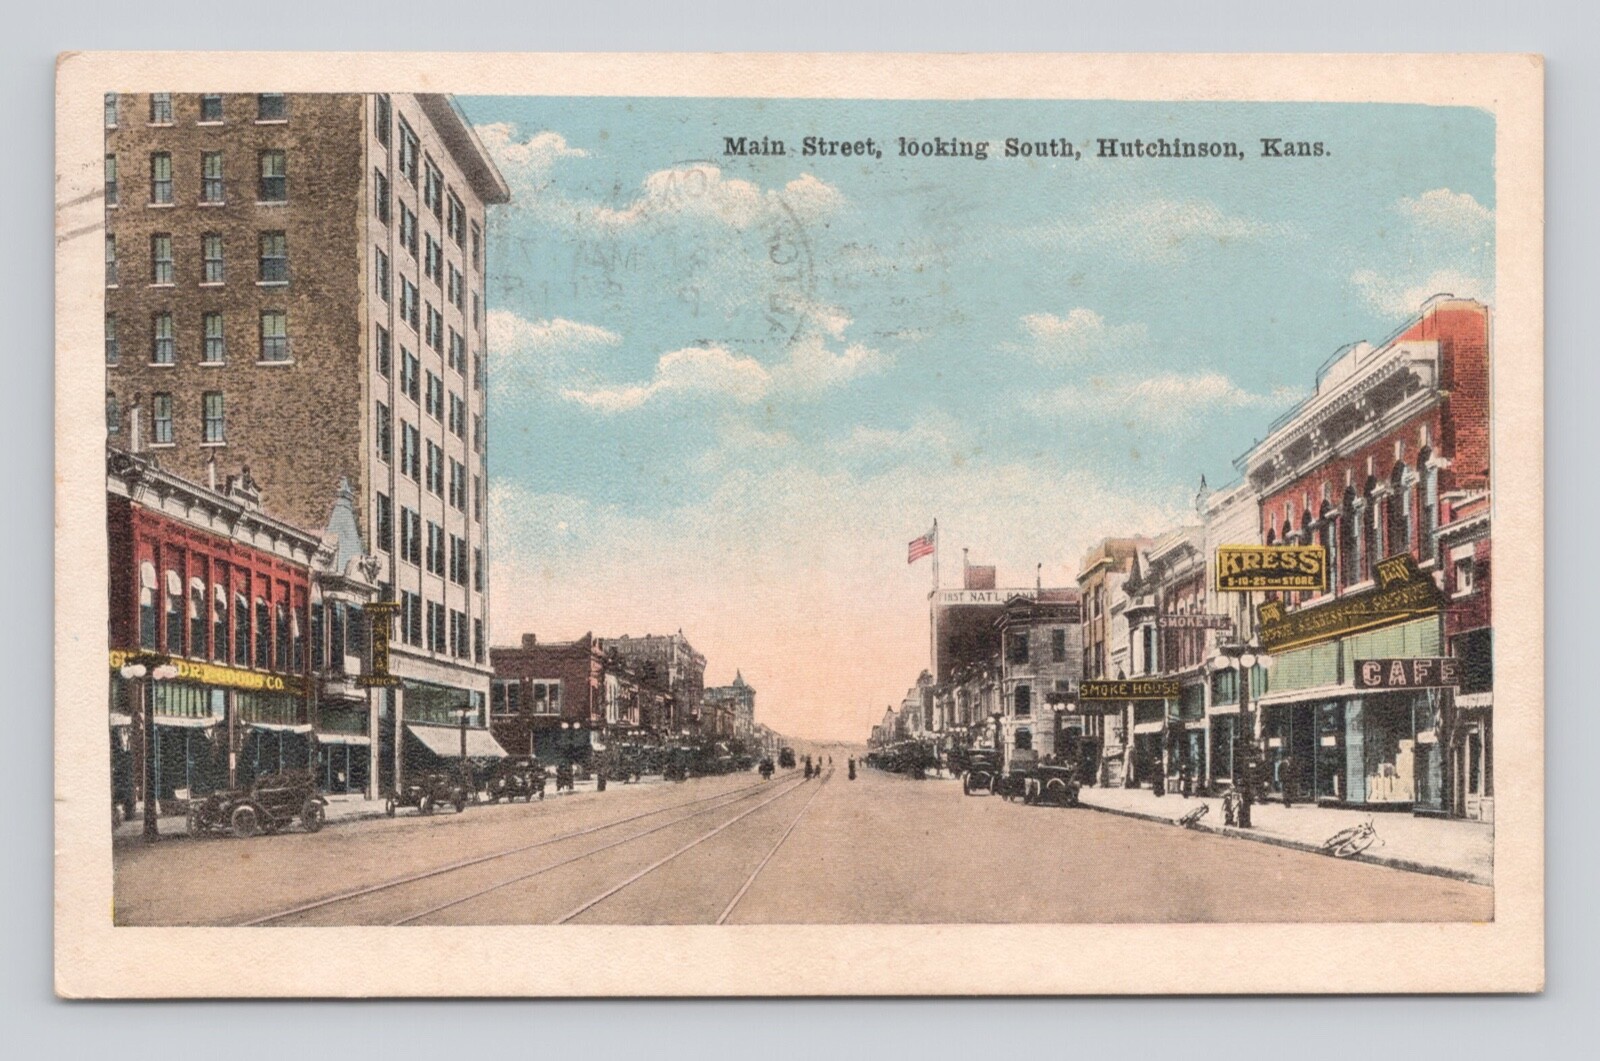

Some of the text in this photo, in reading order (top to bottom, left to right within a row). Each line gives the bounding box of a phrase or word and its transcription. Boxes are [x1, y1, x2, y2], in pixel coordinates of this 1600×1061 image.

[1282, 576, 1315, 586] STORE
[215, 669, 264, 689] GOODS
[265, 676, 285, 690] CO.
[1361, 659, 1459, 686] CAFE
[1080, 681, 1181, 697] SMOKE HOUSE
